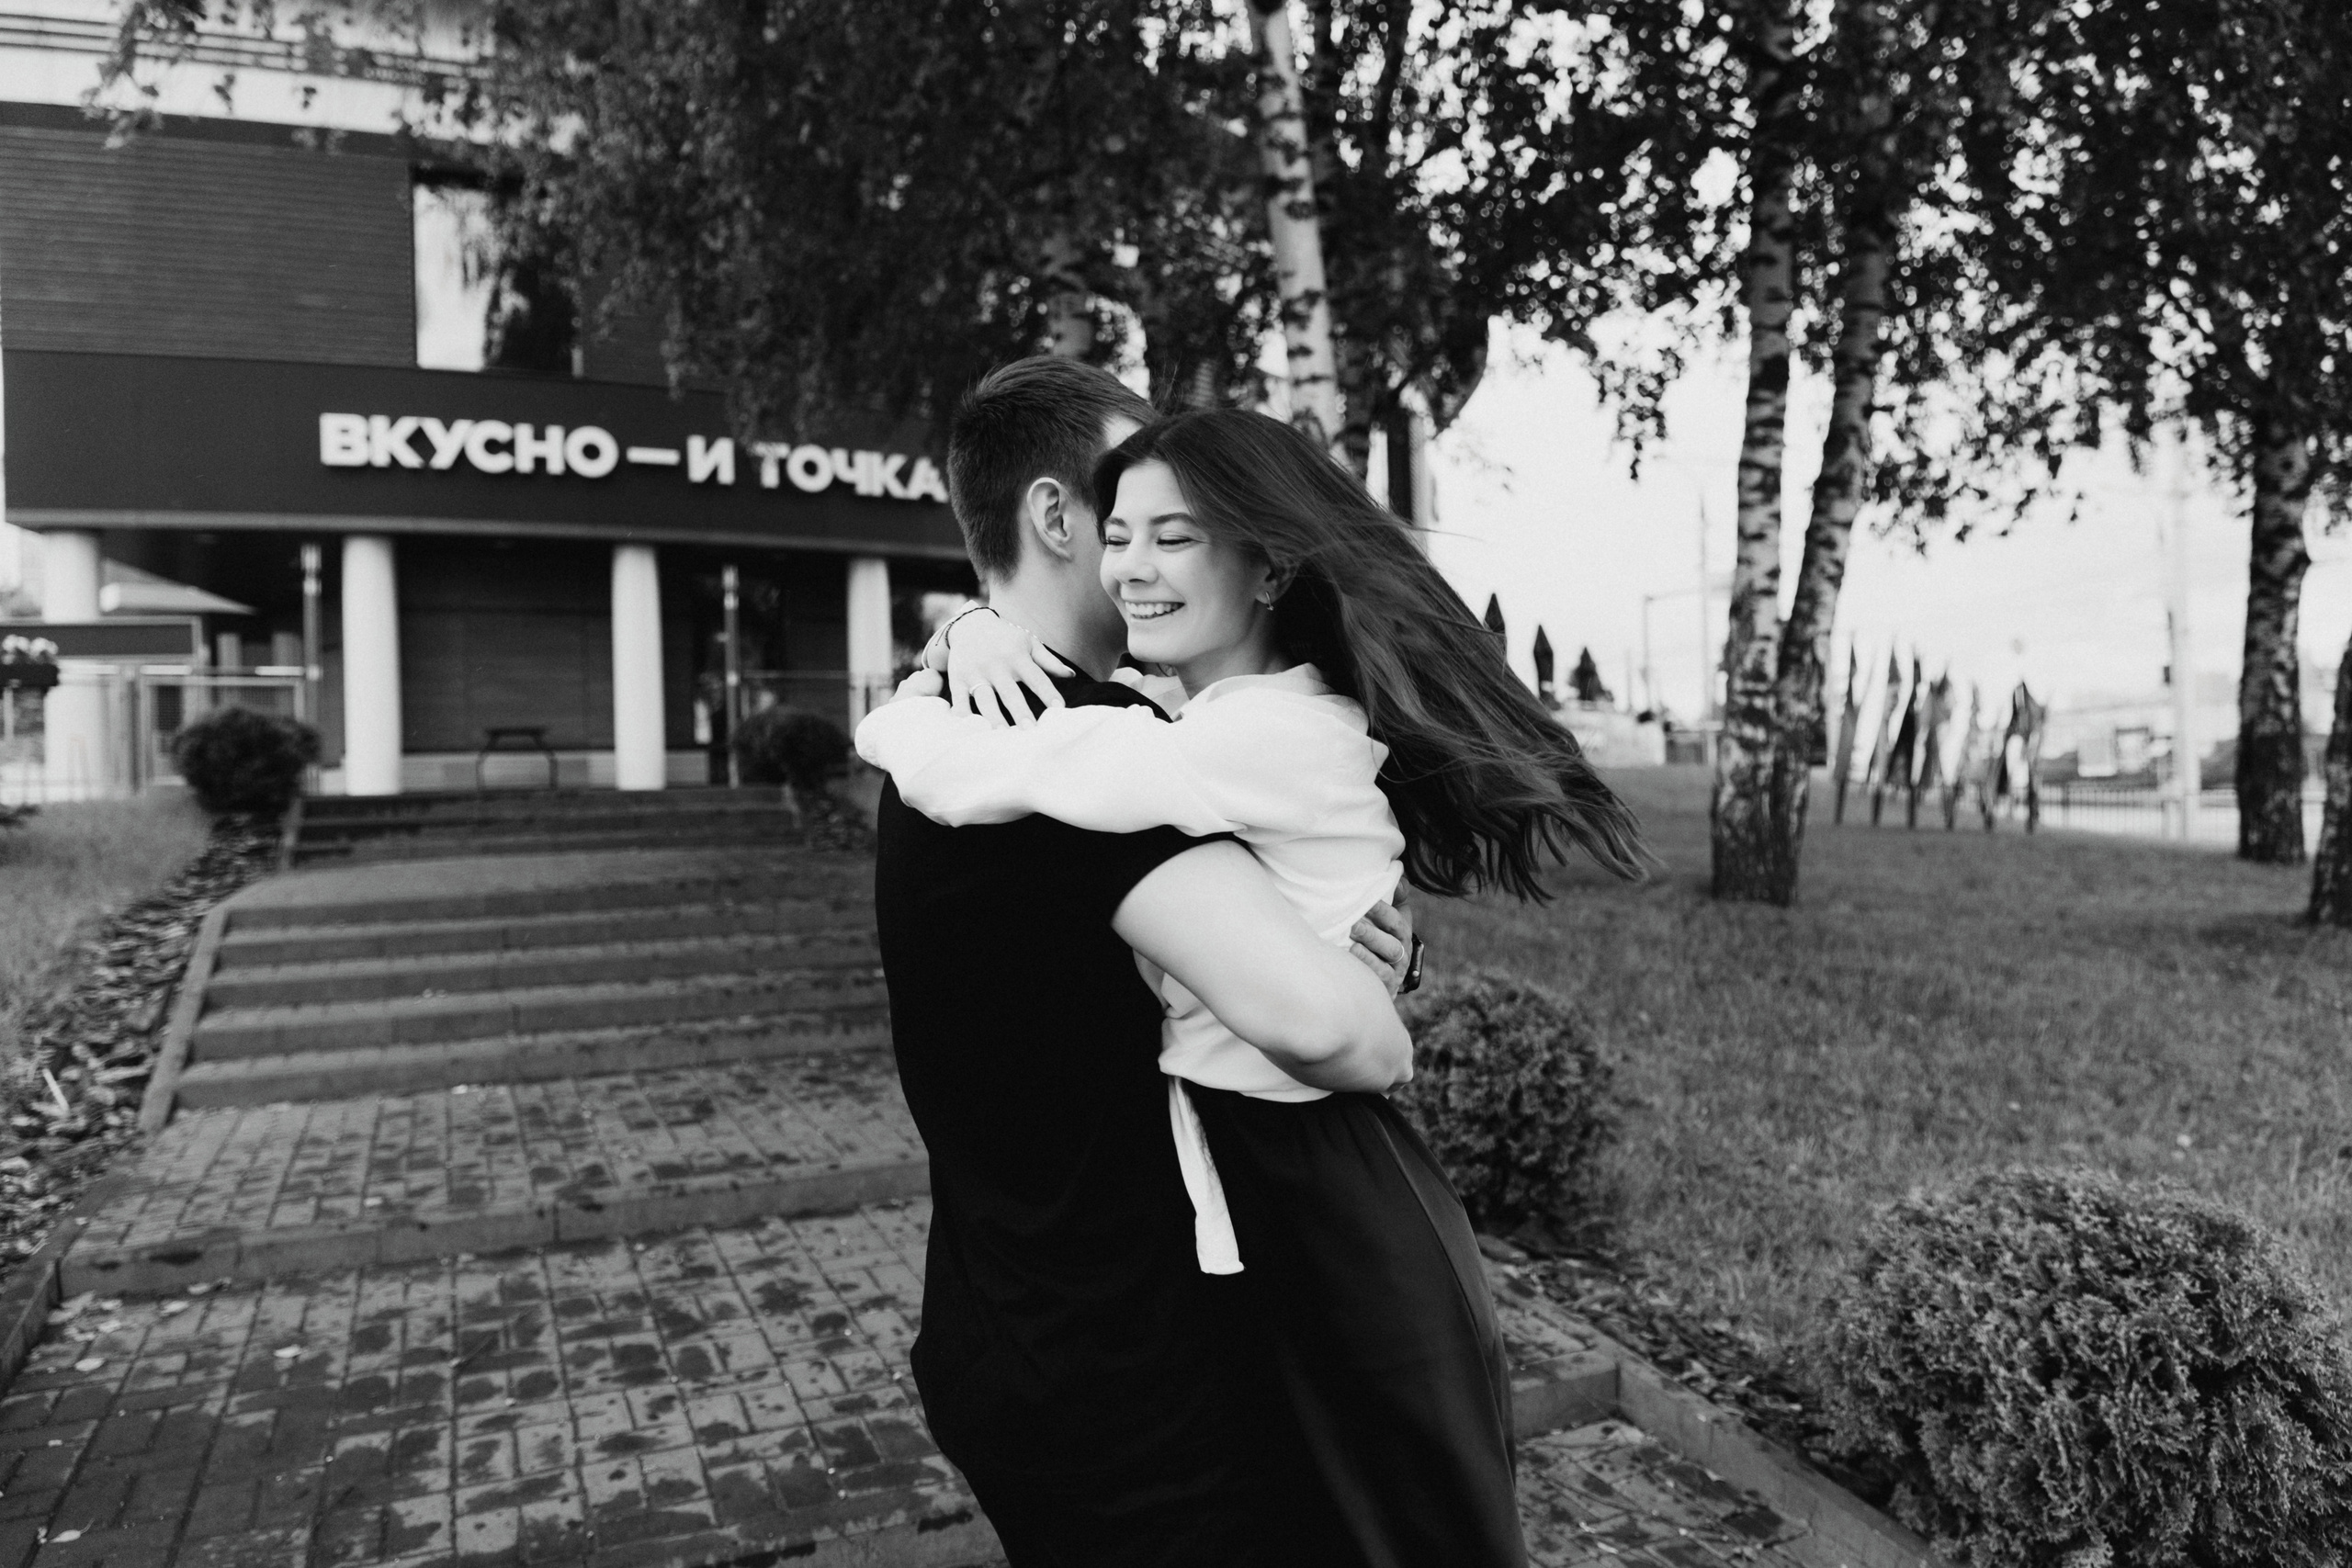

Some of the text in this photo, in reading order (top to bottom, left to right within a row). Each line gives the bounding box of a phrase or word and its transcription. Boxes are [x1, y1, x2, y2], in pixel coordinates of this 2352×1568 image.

[319, 412, 619, 478] ВКУСНО
[686, 434, 736, 484] И
[752, 442, 949, 503] ТОЧКА
